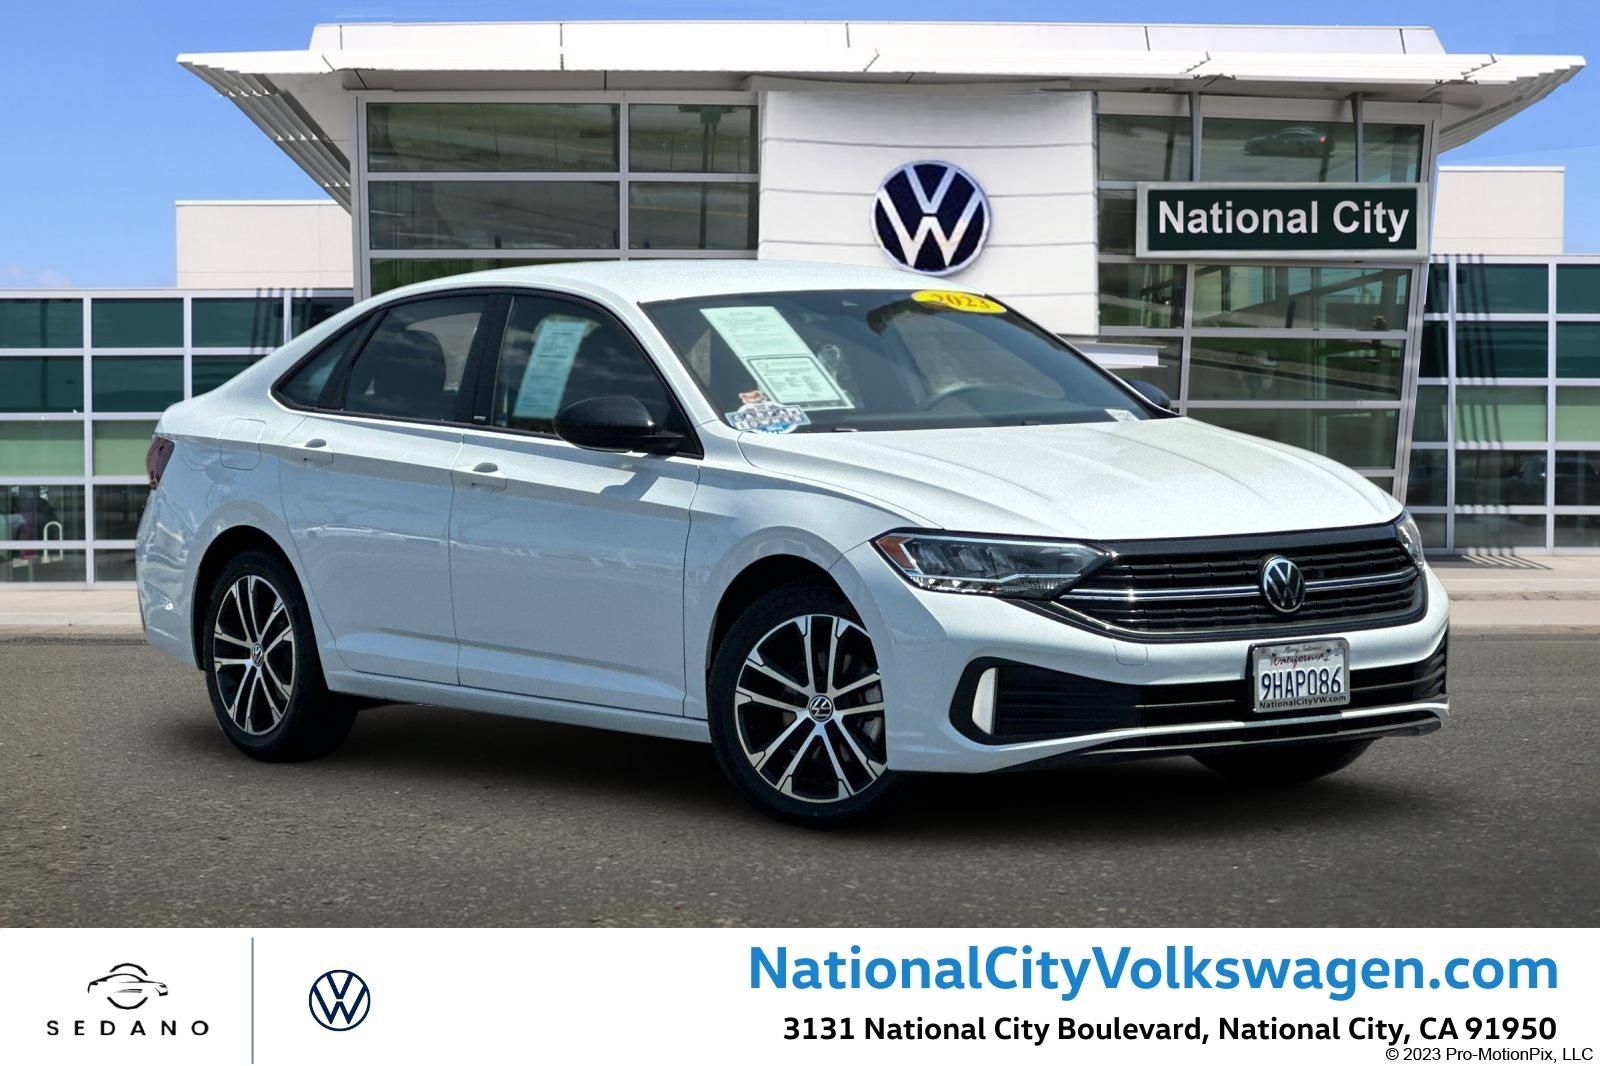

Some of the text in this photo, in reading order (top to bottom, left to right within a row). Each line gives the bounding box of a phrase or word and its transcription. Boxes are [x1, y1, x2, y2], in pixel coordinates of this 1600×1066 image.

[1159, 200, 1410, 243] National City
[929, 293, 990, 309] 2023
[1261, 666, 1341, 700] 9HAP086
[1260, 695, 1346, 709] NationalCityVW.com
